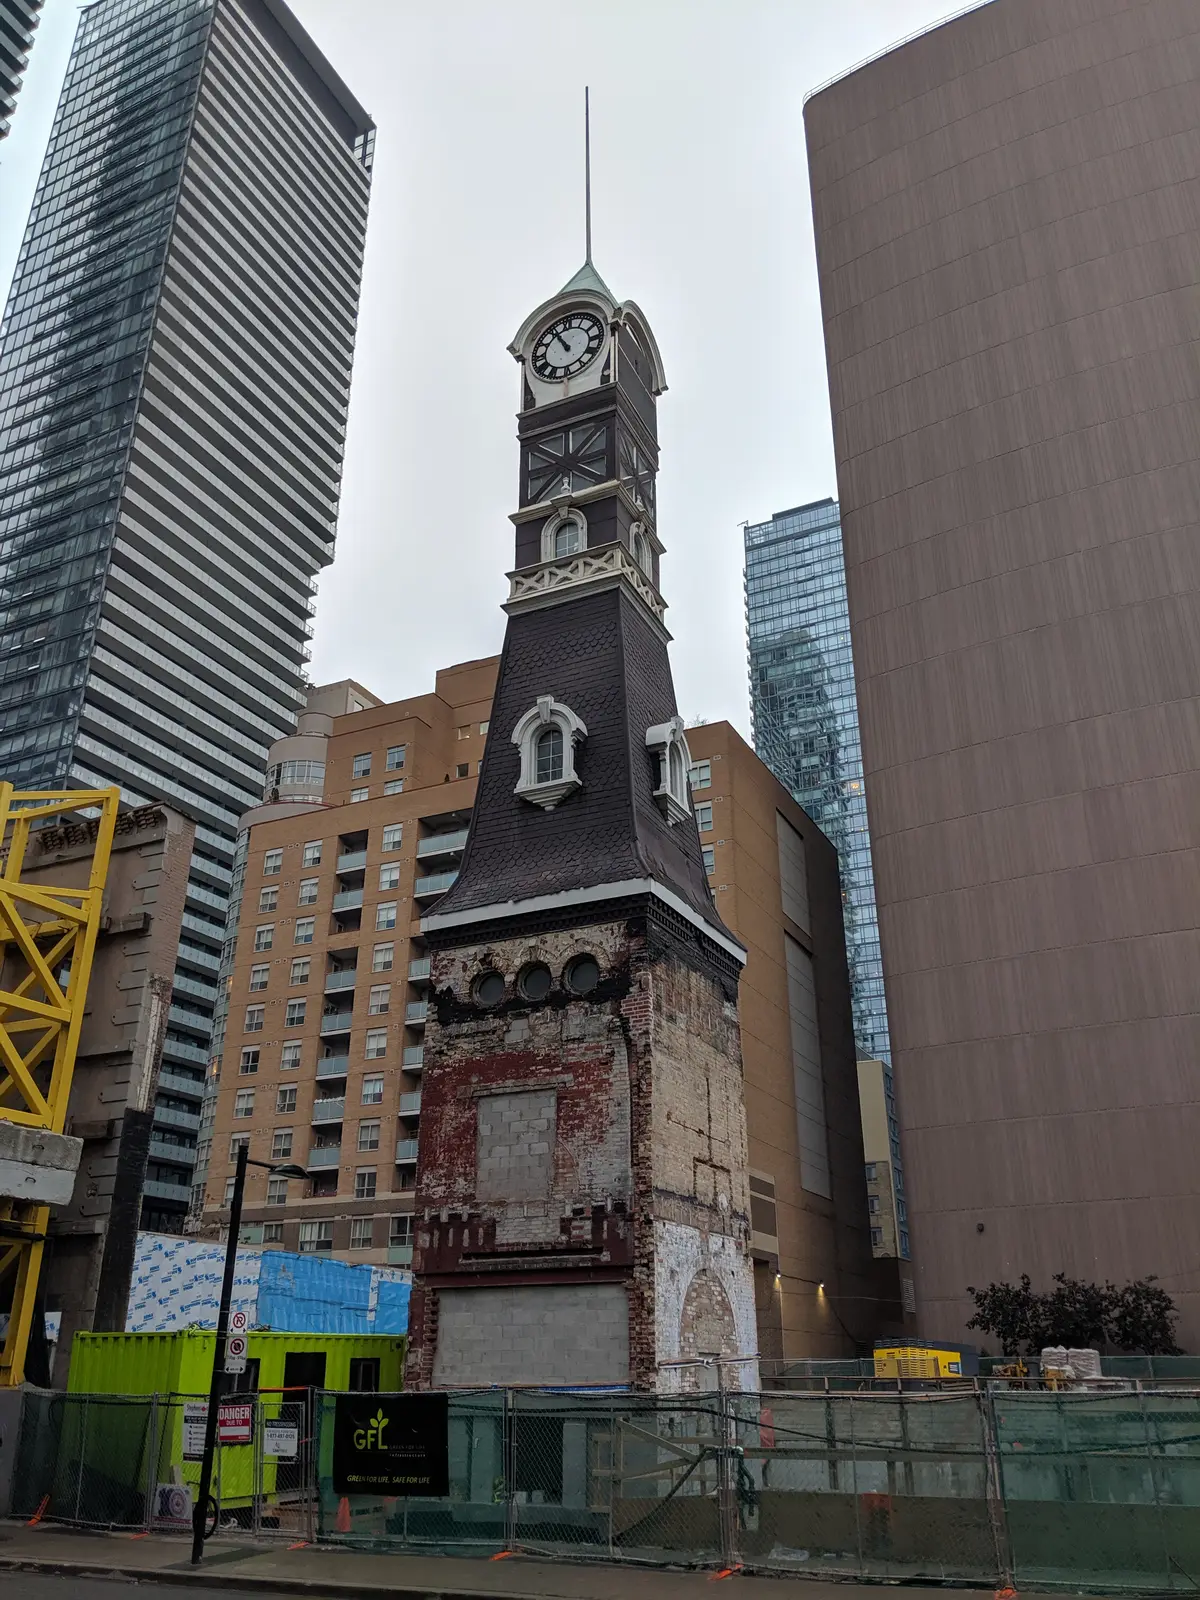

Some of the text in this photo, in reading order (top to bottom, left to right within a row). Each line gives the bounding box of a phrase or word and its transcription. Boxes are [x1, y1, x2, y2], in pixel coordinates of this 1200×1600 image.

[219, 1407, 250, 1420] DANGER
[353, 1426, 389, 1450] GFL
[346, 1474, 366, 1482] GREEN
[392, 1476, 406, 1484] SAFE
[406, 1476, 418, 1484] FOR
[418, 1476, 430, 1484] LIFE
